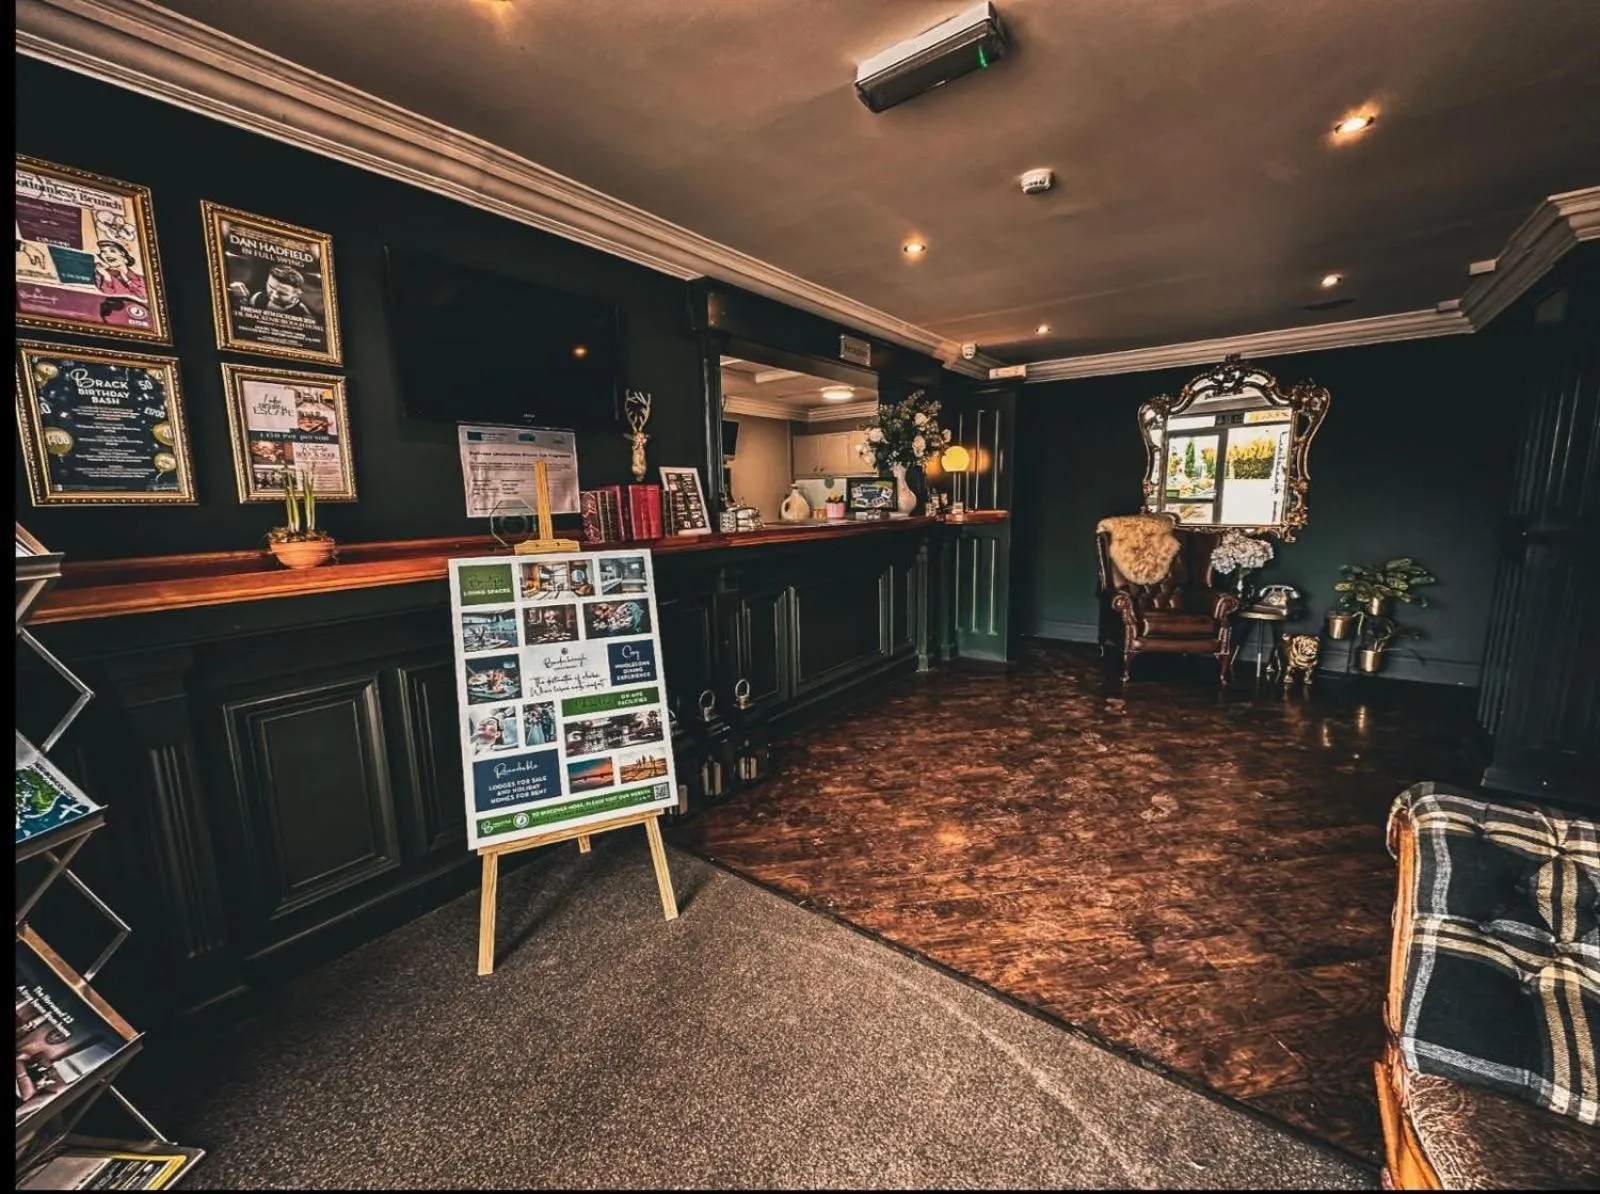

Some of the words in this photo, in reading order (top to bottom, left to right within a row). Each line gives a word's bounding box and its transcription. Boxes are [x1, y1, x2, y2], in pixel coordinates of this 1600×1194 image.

[16, 179, 77, 200] ottomless
[80, 192, 122, 211] Brunch
[230, 234, 257, 248] DAN
[259, 241, 313, 263] HADFIELD
[241, 247, 252, 255] IN
[253, 249, 275, 261] FULL
[277, 256, 304, 268] SWING
[138, 380, 153, 390] 50
[78, 388, 130, 399] BIRTHDAY
[91, 396, 120, 405] BASH
[617, 672, 651, 680] EXPERIENCE
[489, 781, 516, 791] LODGES
[512, 784, 541, 793] HOLIDAY
[490, 795, 515, 803] HOMES
[33, 985, 44, 997] The
[42, 994, 66, 1017] Norwood
[30, 999, 47, 1014] home
[55, 1021, 72, 1037] home
